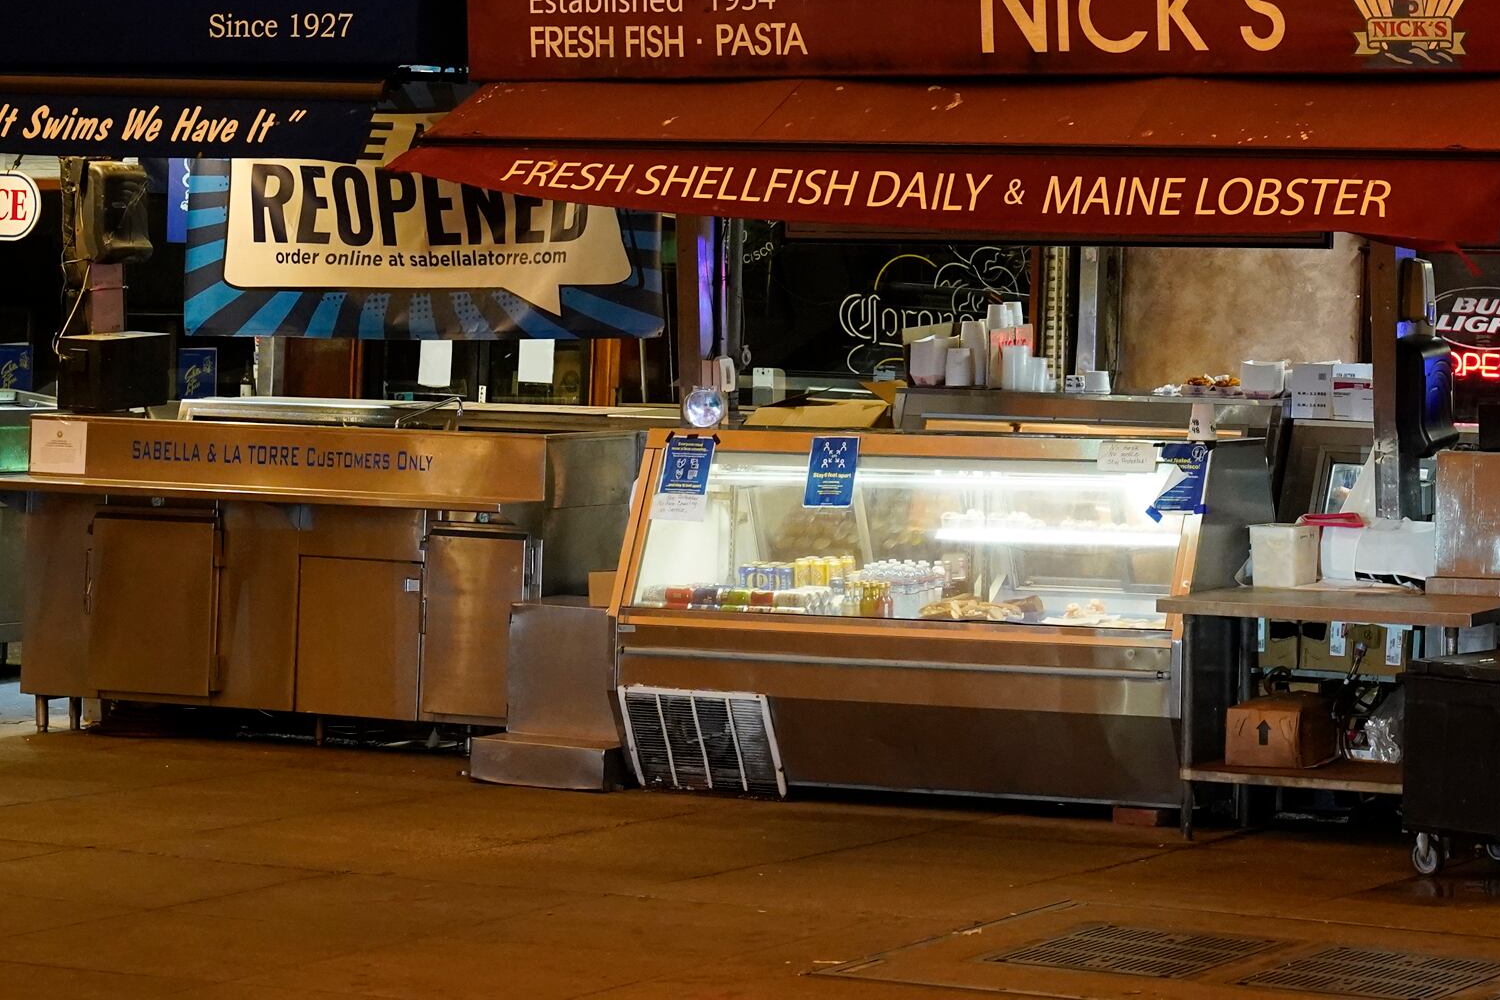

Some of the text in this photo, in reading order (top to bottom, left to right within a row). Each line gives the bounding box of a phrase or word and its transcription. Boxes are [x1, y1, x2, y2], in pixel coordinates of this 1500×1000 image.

[208, 13, 353, 38] Since 1927
[530, 23, 808, 58] FRESH FISH PASTA
[1372, 20, 1448, 38] NICK'S
[22, 104, 113, 141] Swims
[121, 105, 163, 142] We
[170, 106, 239, 143] Have
[500, 160, 1391, 218] FRESH SHELLFISH DAILY & MAINE LOBSTER
[251, 163, 589, 246] REOPENED
[275, 249, 567, 268] order online at sabellalatorre.com
[132, 440, 200, 462] SABELLA
[207, 444, 217, 463] &
[223, 444, 241, 465] LA
[248, 445, 299, 466] TORRE
